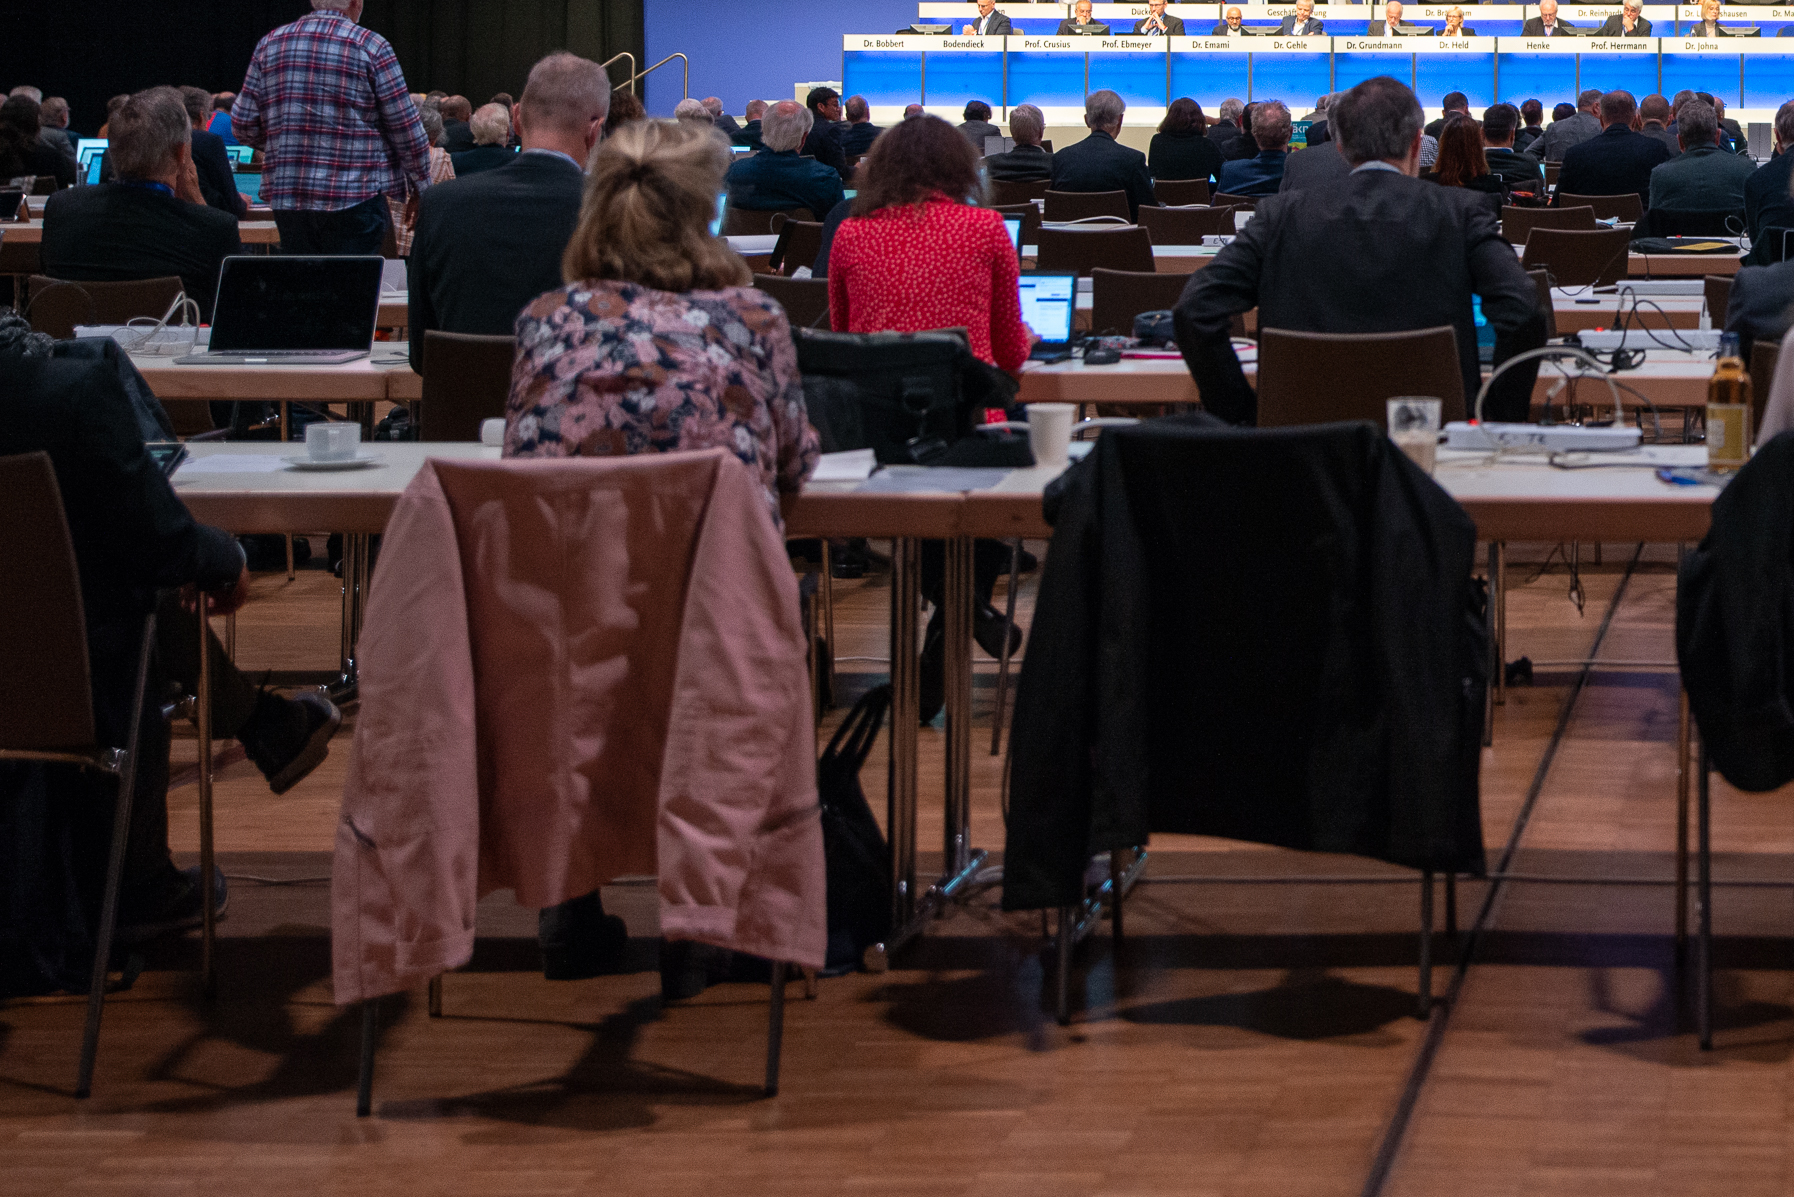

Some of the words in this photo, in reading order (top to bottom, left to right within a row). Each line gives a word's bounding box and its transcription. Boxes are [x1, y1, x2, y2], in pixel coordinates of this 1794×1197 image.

[1425, 9, 1435, 17] Dr.
[863, 40, 874, 48] Dr.
[876, 39, 904, 48] Bobbert
[943, 39, 985, 48] Bodendieck
[1024, 40, 1042, 48] Prof.
[1043, 40, 1071, 48] Crusius
[1102, 40, 1119, 48] Prof.
[1121, 40, 1152, 50] Ebmeyer
[1192, 41, 1203, 49] Dr.
[1204, 40, 1230, 49] Emami
[1273, 41, 1284, 49] Dr.
[1286, 41, 1308, 50] Gehle
[1346, 41, 1357, 50] Dr.
[1358, 41, 1403, 50] Grundmann
[1439, 41, 1450, 49] Dr.
[1451, 41, 1469, 49] Held
[1526, 41, 1550, 50] Henke
[1591, 41, 1608, 50] Prof.
[1610, 42, 1647, 50] Herrmann
[1685, 42, 1696, 50] Dr.
[1697, 42, 1719, 51] Johna
